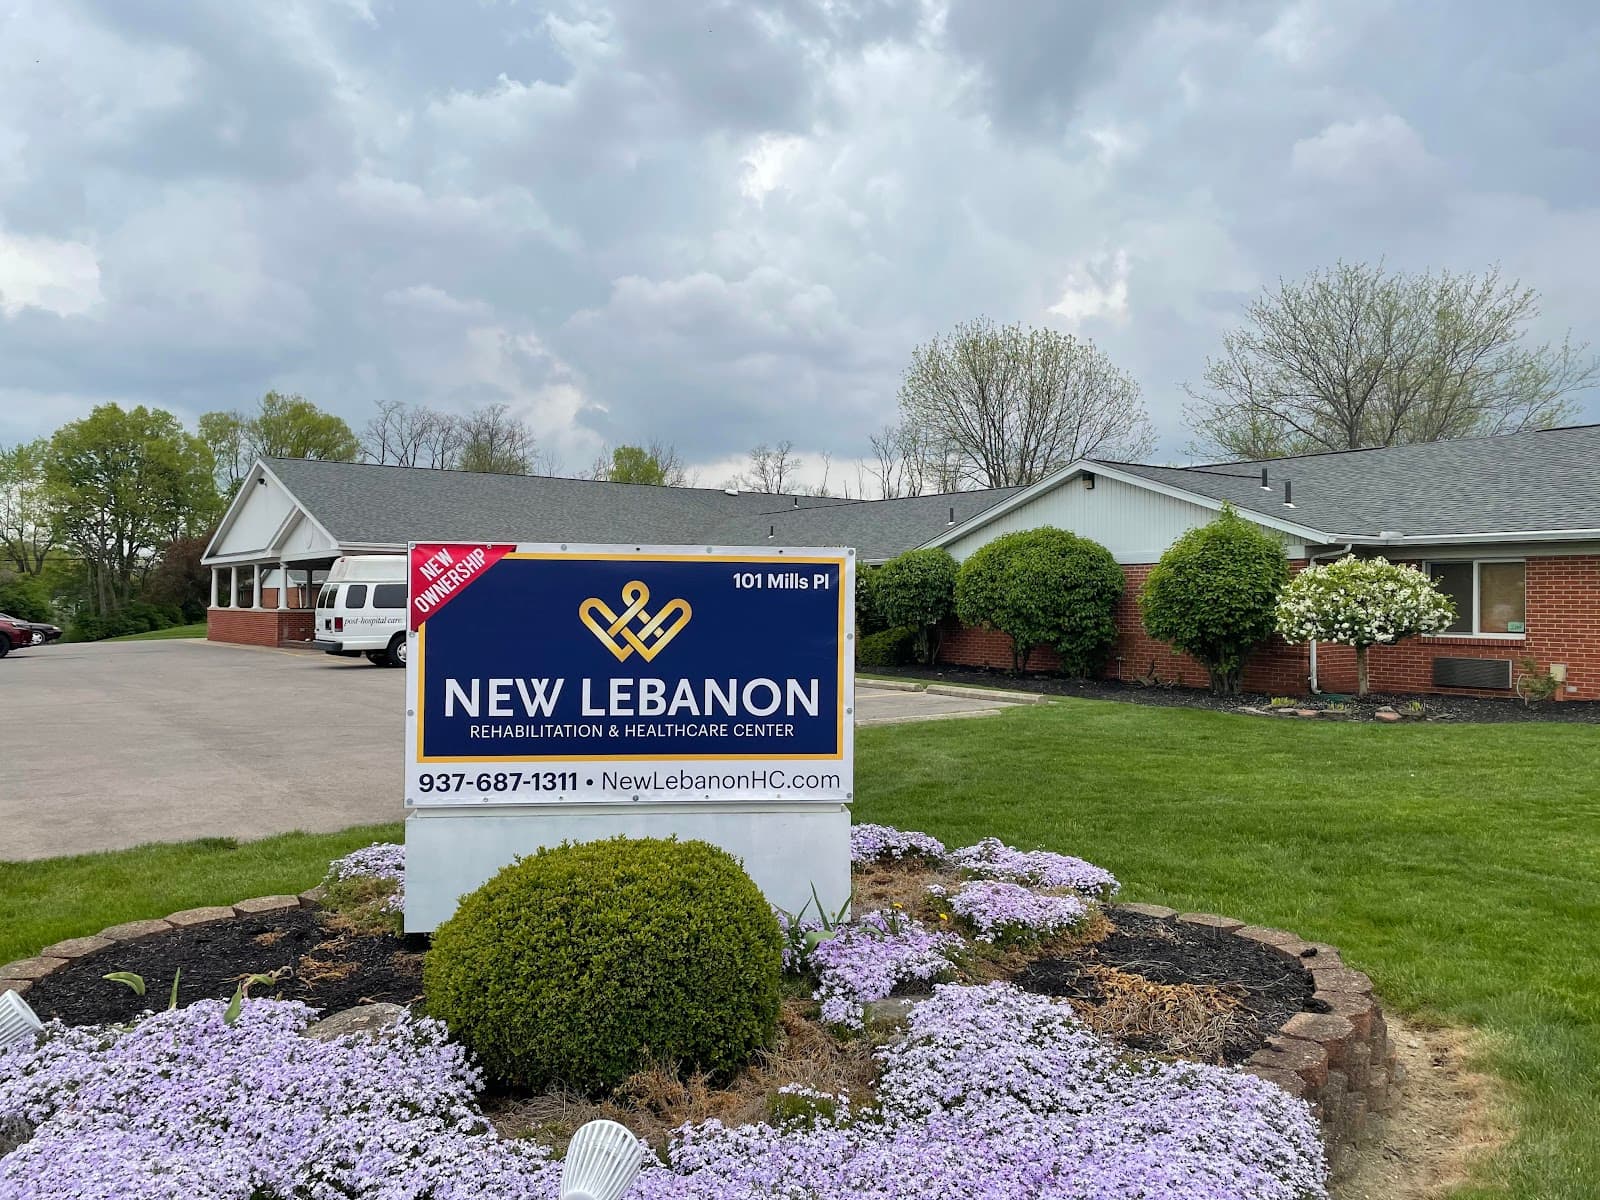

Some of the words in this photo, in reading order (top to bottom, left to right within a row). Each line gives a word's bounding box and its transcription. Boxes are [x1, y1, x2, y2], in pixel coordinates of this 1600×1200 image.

[419, 548, 454, 582] NEW
[414, 548, 486, 613] OWNERSHIP
[733, 573, 762, 588] 101
[767, 573, 808, 589] Mills
[813, 574, 829, 589] Pl
[445, 678, 564, 717] NEW
[582, 678, 819, 716] LEBANON
[470, 724, 603, 738] REHABILITATION
[608, 724, 619, 738] &
[624, 724, 728, 738] HEALTHCARE
[733, 724, 794, 737] CENTER
[418, 772, 577, 793] 937-687-1311
[602, 770, 840, 790] NewLebanonHC.com
